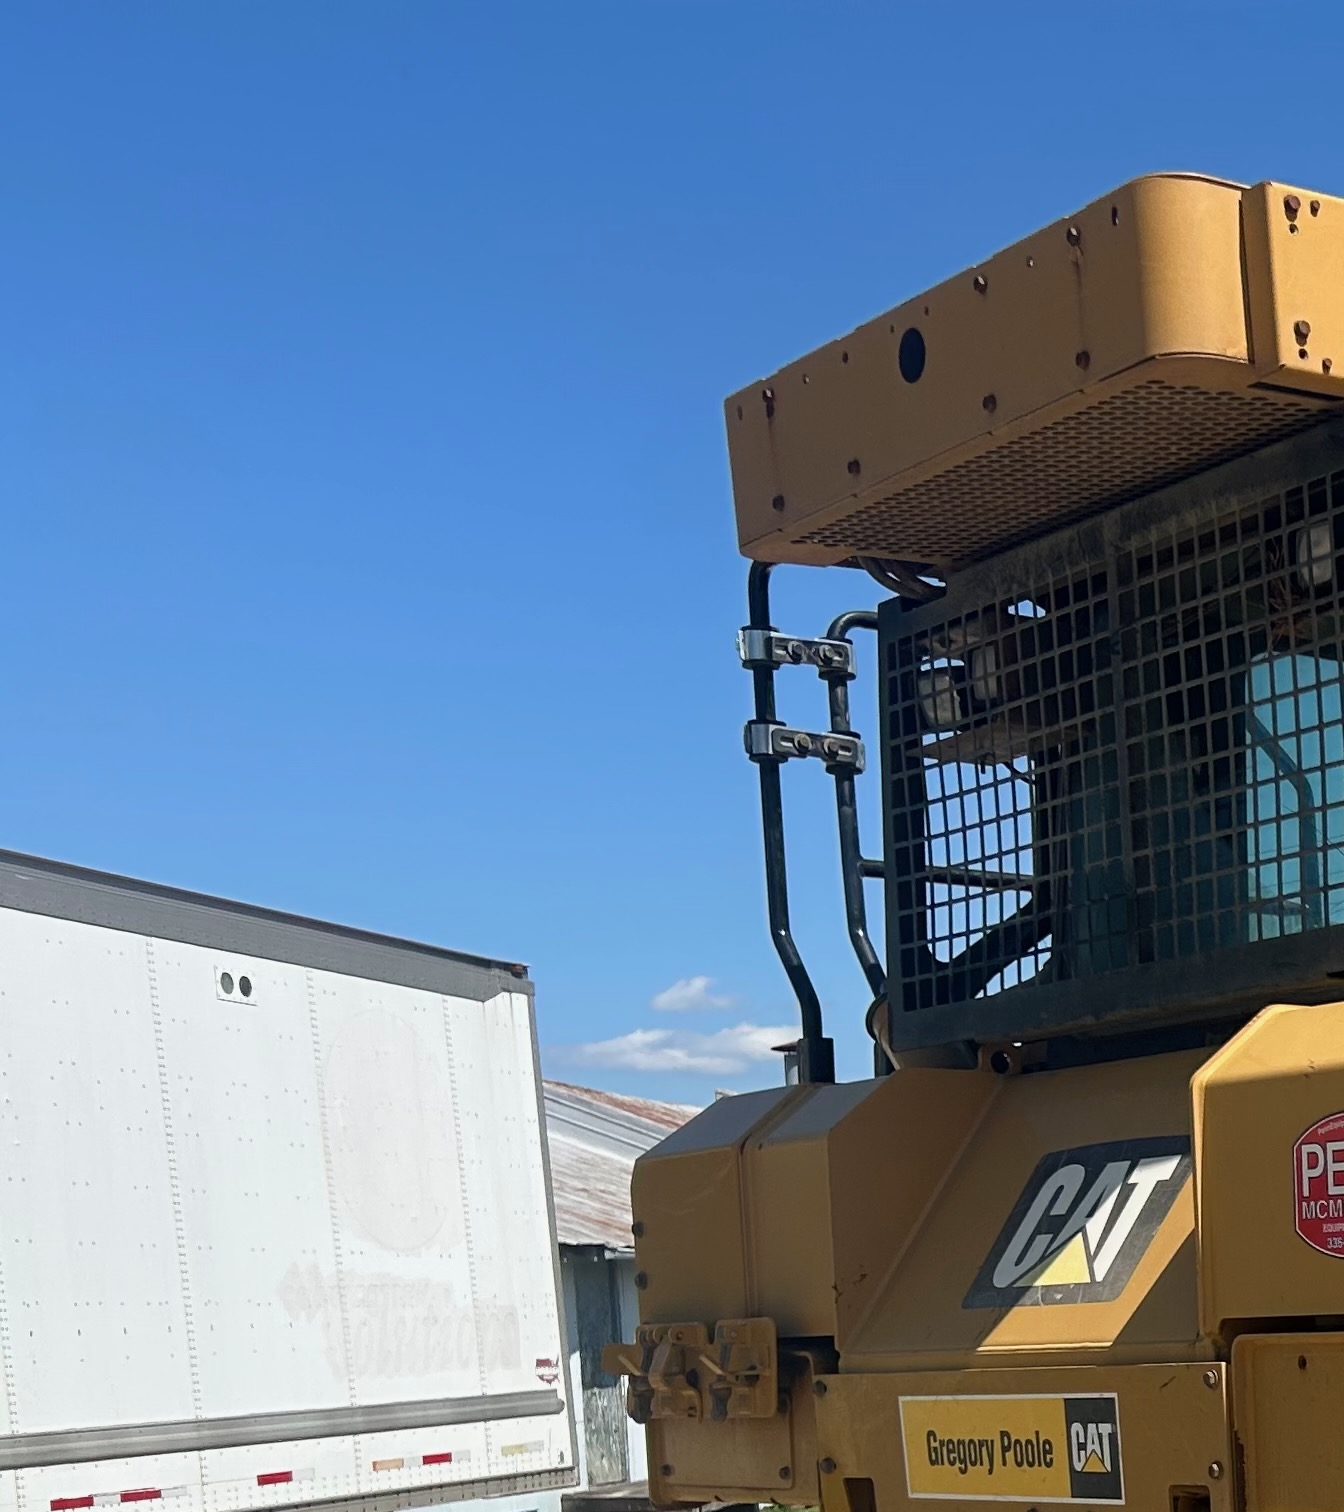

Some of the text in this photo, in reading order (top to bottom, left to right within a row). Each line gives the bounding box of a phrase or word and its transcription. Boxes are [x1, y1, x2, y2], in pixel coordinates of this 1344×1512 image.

[993, 1154, 1184, 1288] CAT
[926, 1429, 1054, 1475] Gregory Poole
[1071, 1422, 1112, 1473] CAT
